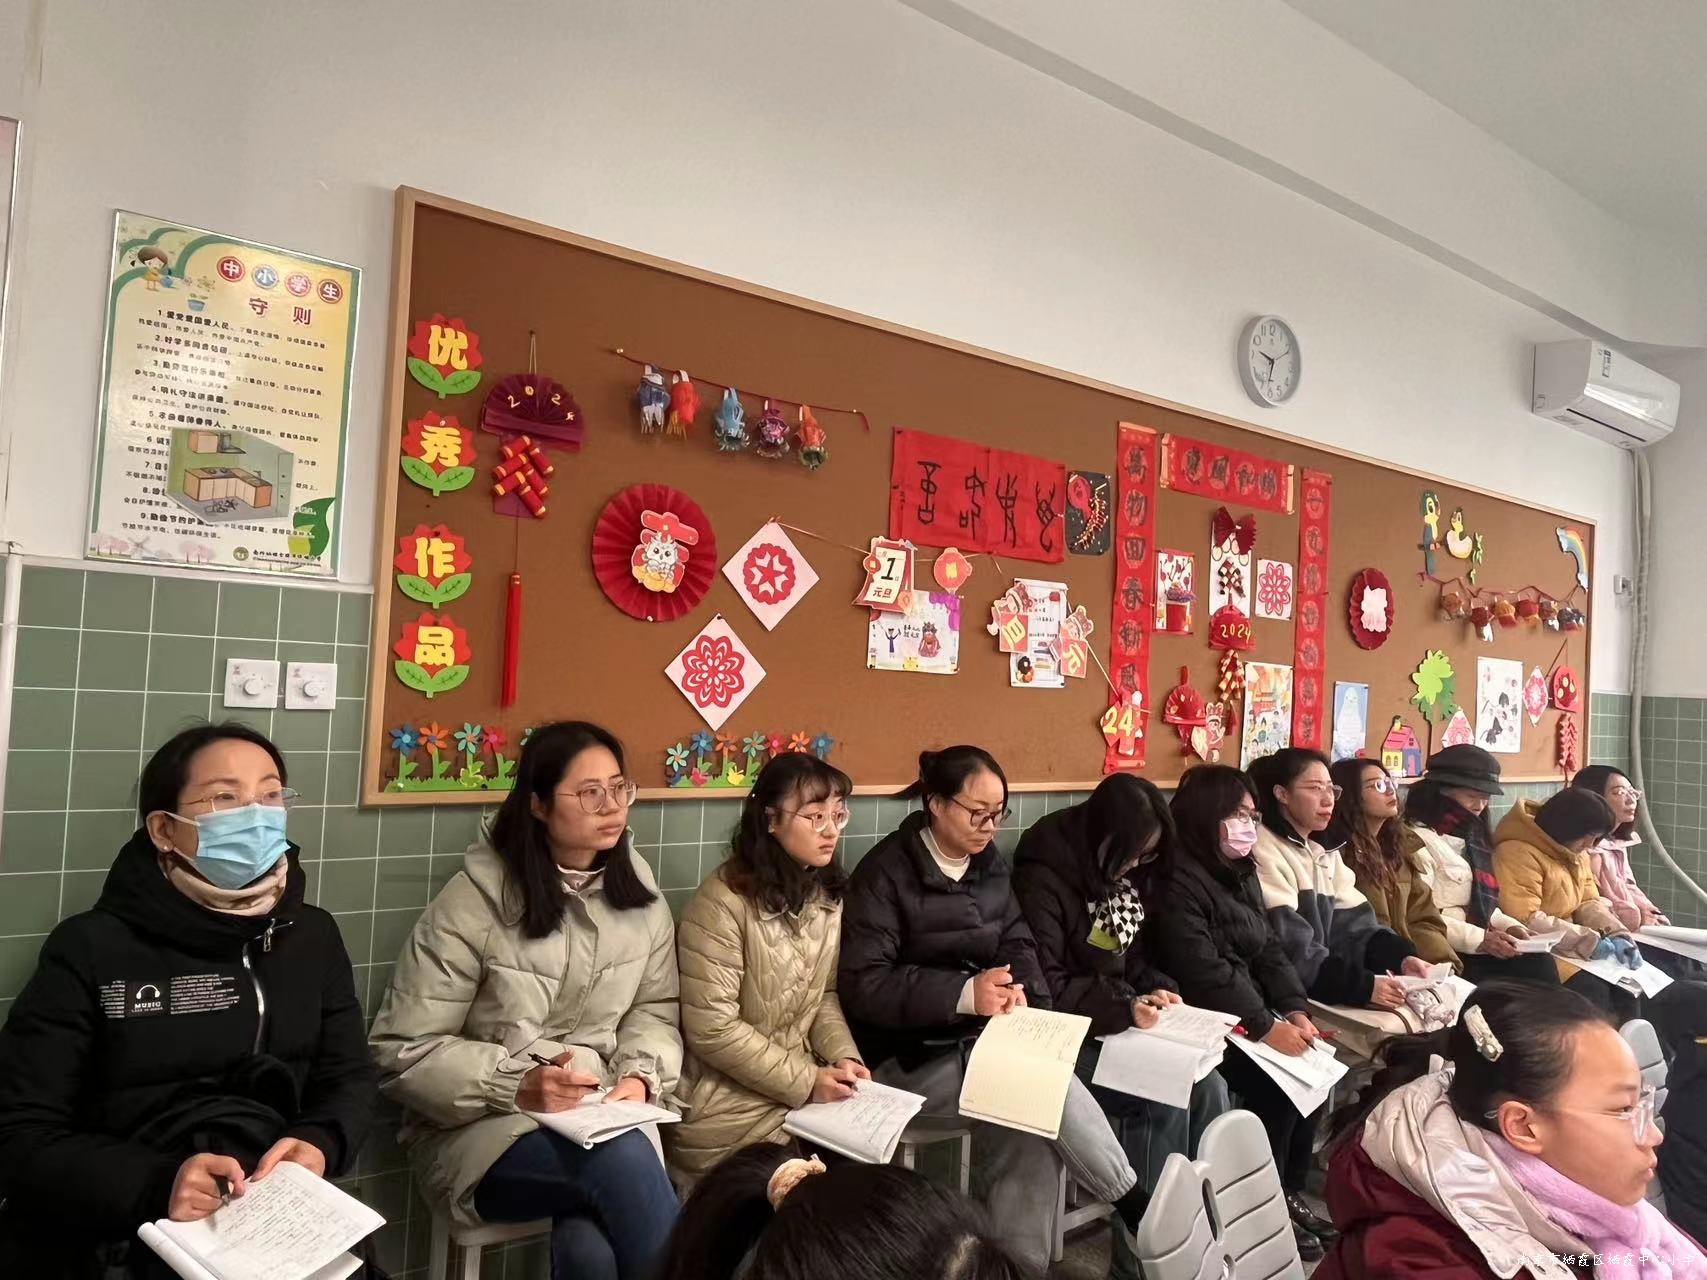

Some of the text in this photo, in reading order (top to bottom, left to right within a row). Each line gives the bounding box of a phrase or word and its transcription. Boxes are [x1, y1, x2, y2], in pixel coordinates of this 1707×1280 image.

[223, 260, 339, 301] 中小学生
[249, 298, 312, 325] 守则
[872, 587, 893, 599] 元旦
[1219, 623, 1251, 641] 2024
[1102, 706, 1134, 737] 24
[134, 1001, 161, 1009] MUSIC
